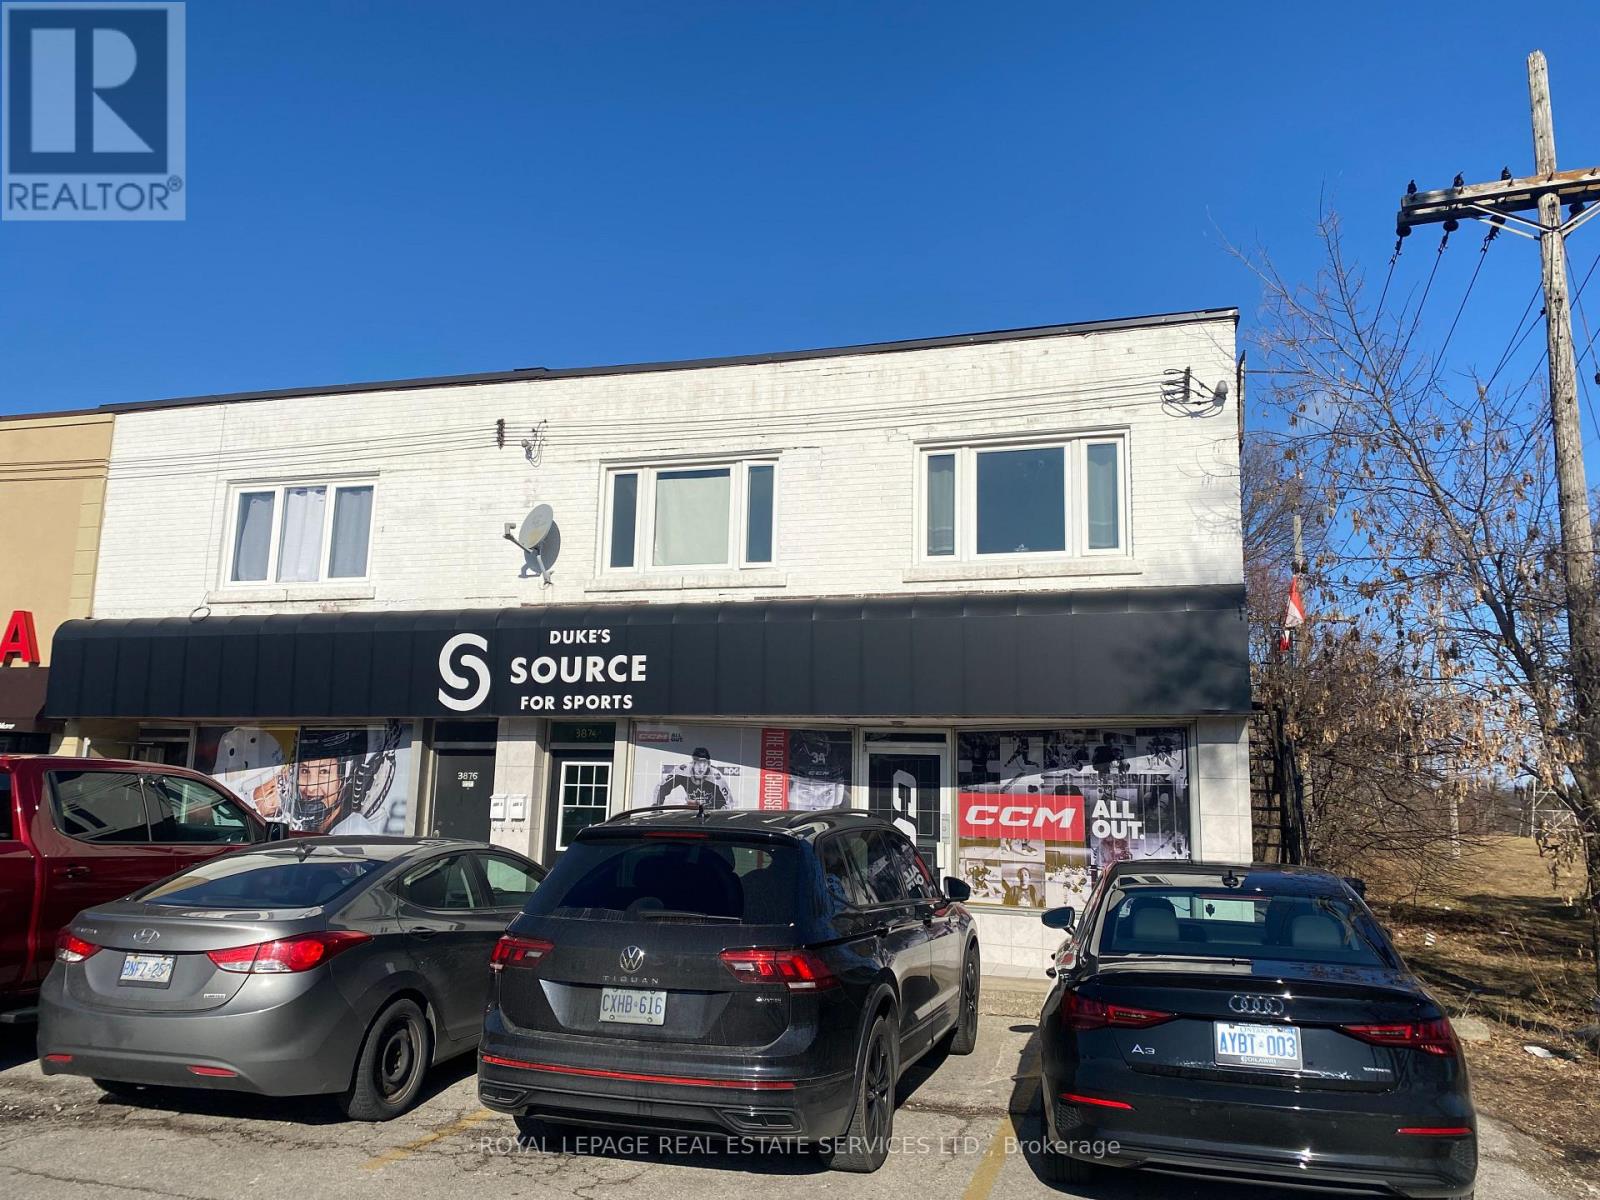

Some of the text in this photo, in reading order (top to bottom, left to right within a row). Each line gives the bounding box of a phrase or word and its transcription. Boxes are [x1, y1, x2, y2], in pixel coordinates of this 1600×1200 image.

[549, 629, 611, 645] DUKE'S
[510, 654, 647, 684] SOURCE
[520, 694, 633, 710] FOR SPORTS
[766, 732, 785, 747] THE
[765, 750, 784, 771] BEST
[811, 752, 826, 764] 34
[457, 772, 479, 780] 3876
[965, 805, 1076, 828] CCM
[1092, 800, 1135, 819] ALL
[1092, 820, 1145, 840] OUT.
[602, 994, 662, 1015] CXHB 616
[1131, 1043, 1155, 1055] A3
[1220, 1031, 1255, 1054] AYBT
